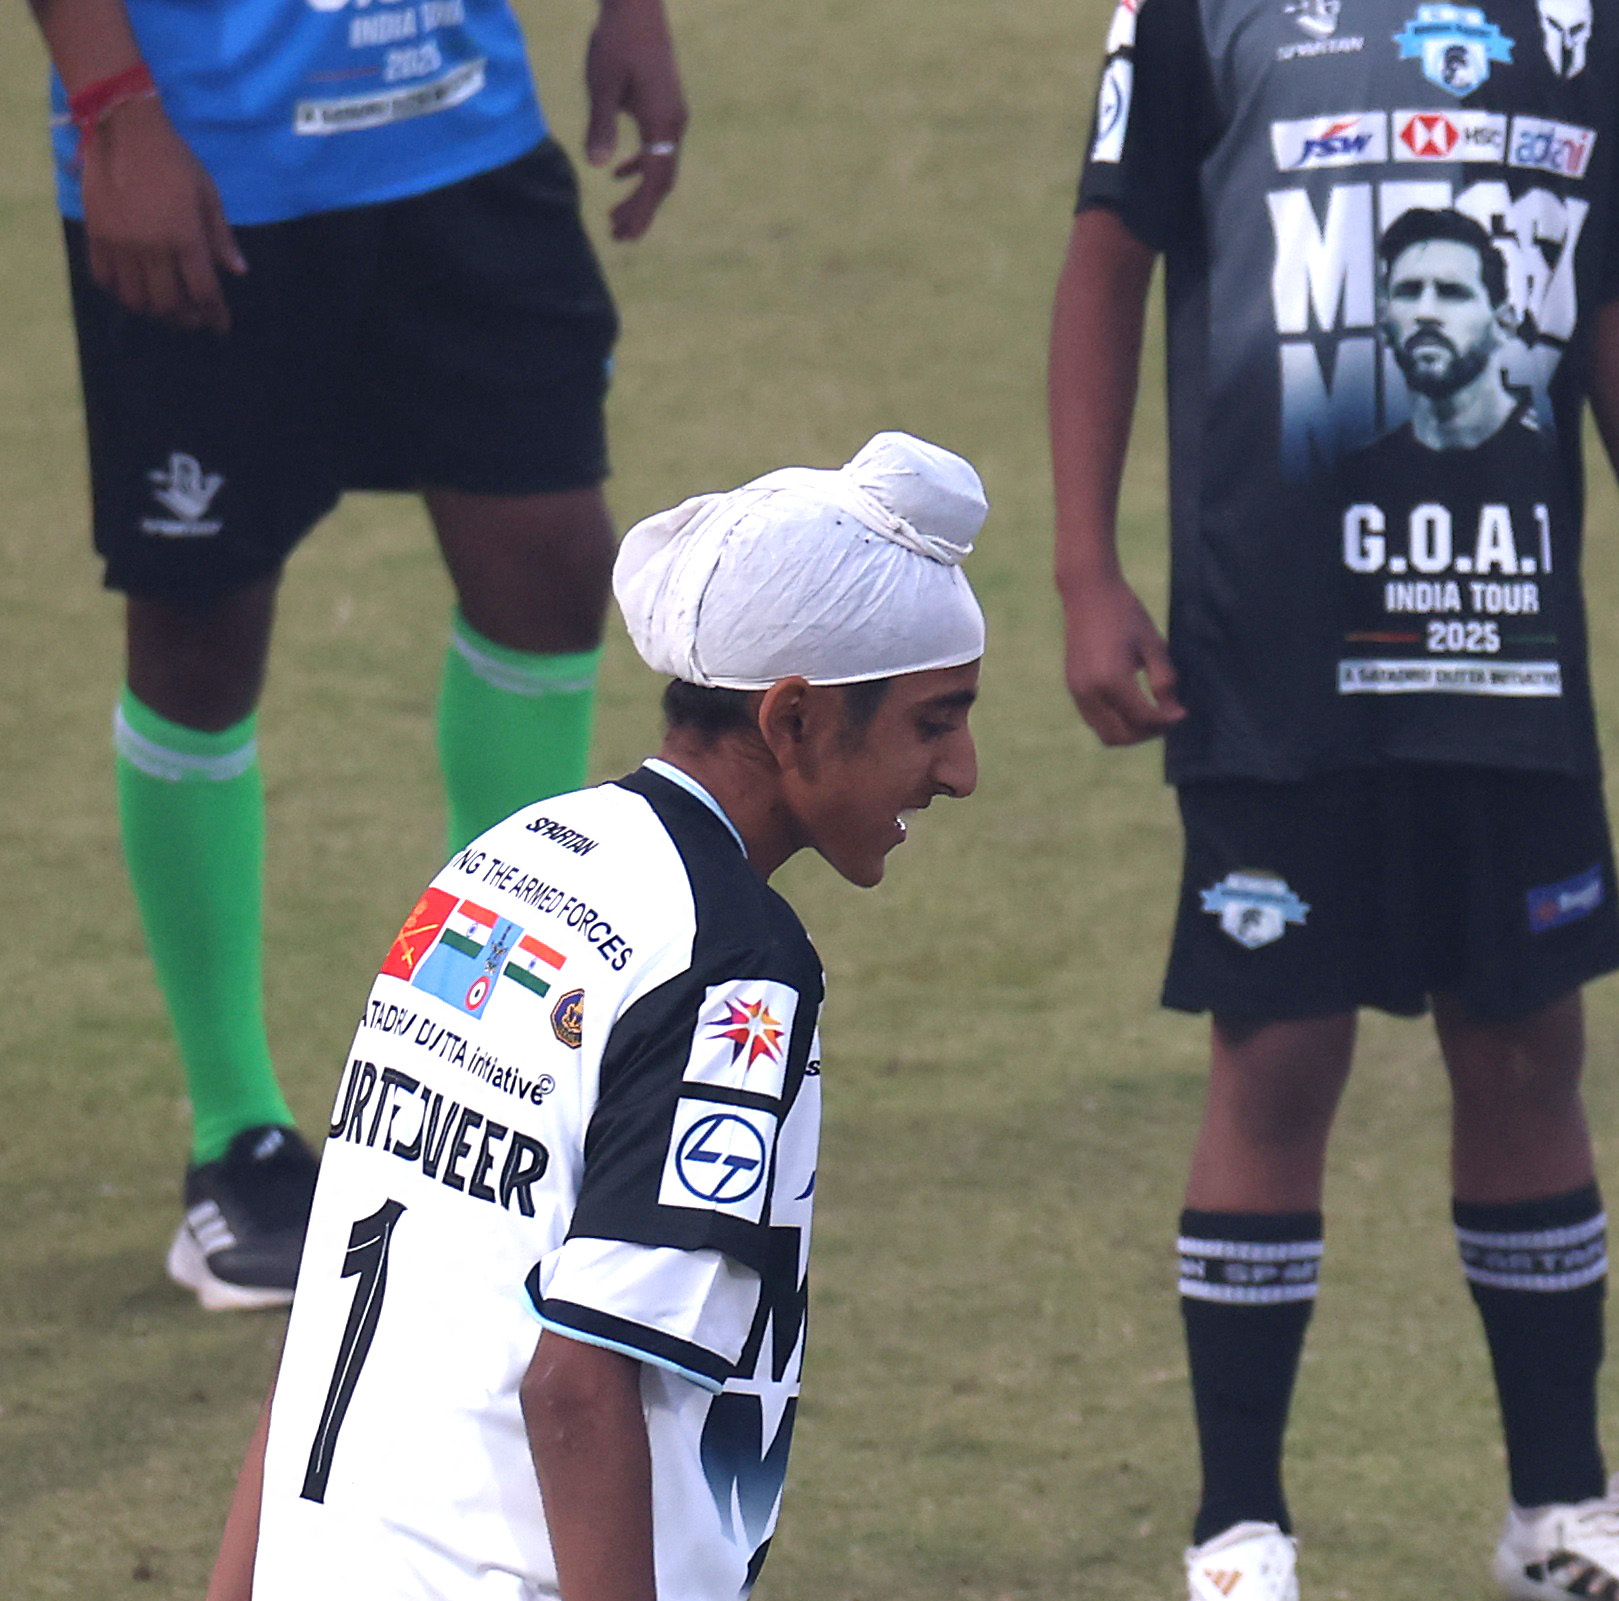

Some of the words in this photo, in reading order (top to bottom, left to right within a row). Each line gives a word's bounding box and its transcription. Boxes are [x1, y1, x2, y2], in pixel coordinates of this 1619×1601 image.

[1385, 582, 1461, 614] INDIA
[1471, 583, 1539, 615] TOUR
[1426, 621, 1501, 653] 2025
[526, 817, 599, 857] SPARTAN
[482, 858, 519, 890] THE
[509, 874, 565, 913] ARMED
[557, 896, 633, 971] FORCES
[300, 1198, 407, 1504] 1
